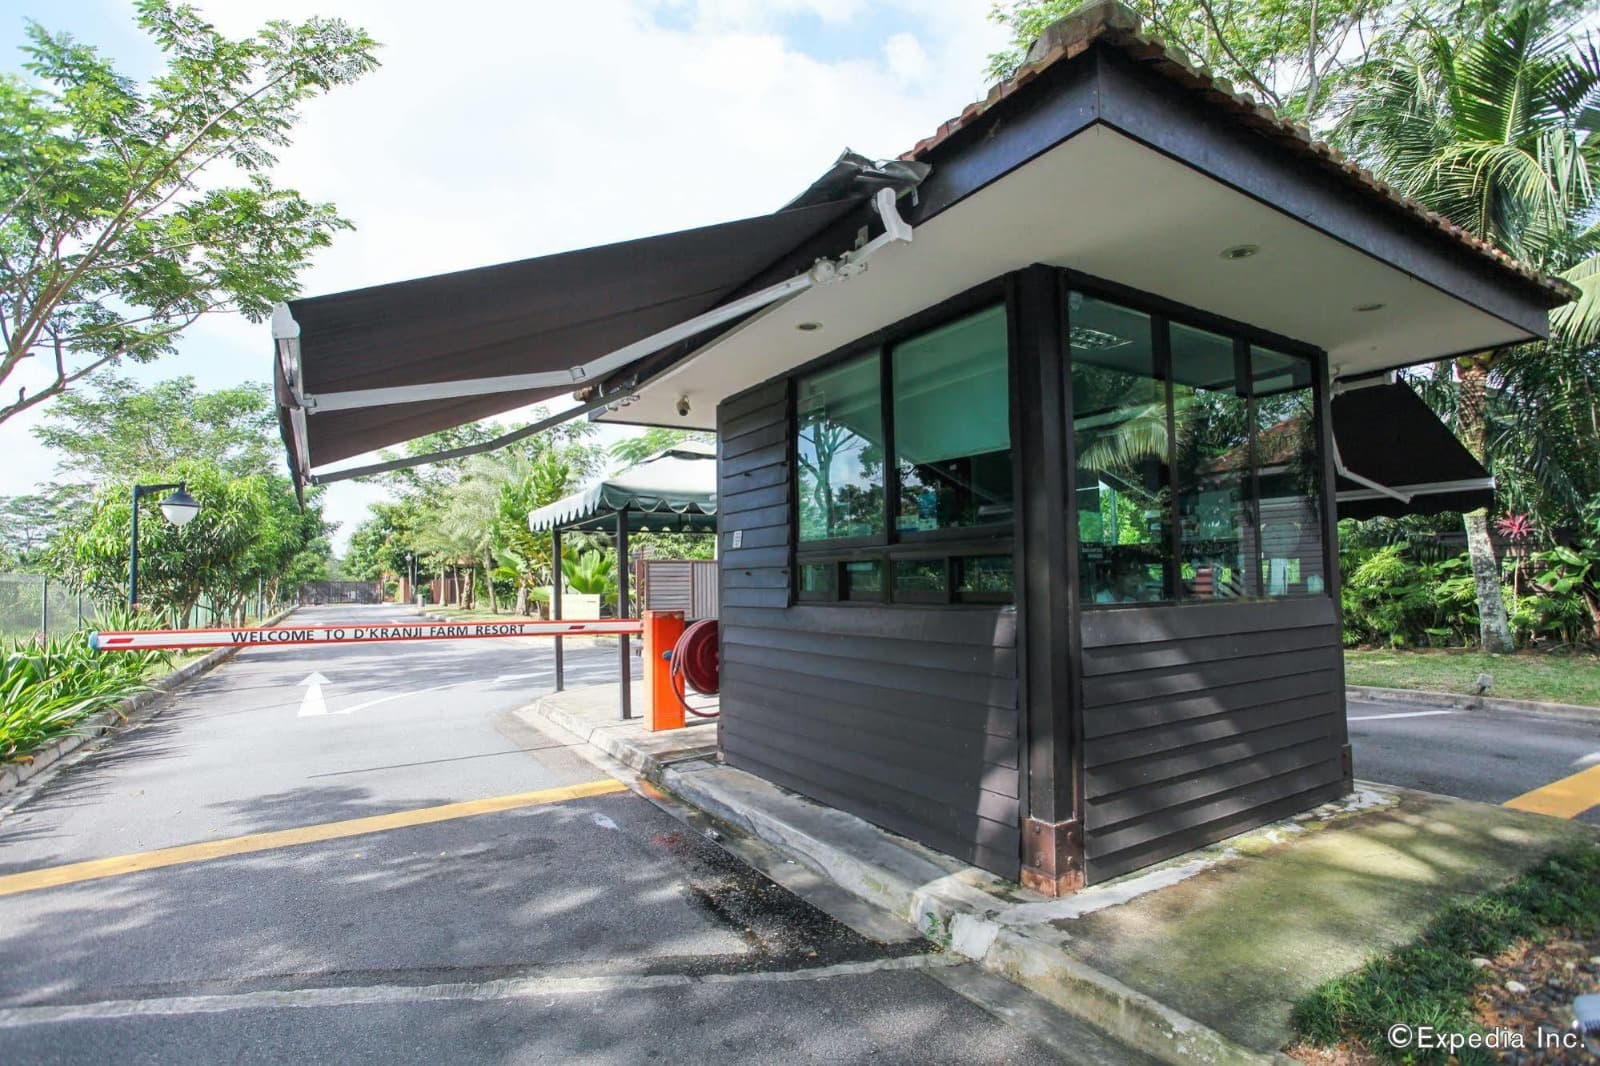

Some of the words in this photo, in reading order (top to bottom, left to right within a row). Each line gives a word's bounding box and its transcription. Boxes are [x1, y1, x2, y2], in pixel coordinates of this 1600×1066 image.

[231, 630, 314, 642] WELCOME
[324, 629, 345, 640] TO
[354, 627, 422, 638] D'KRANJI
[430, 626, 468, 637] FARM
[476, 624, 525, 635] RESORT
